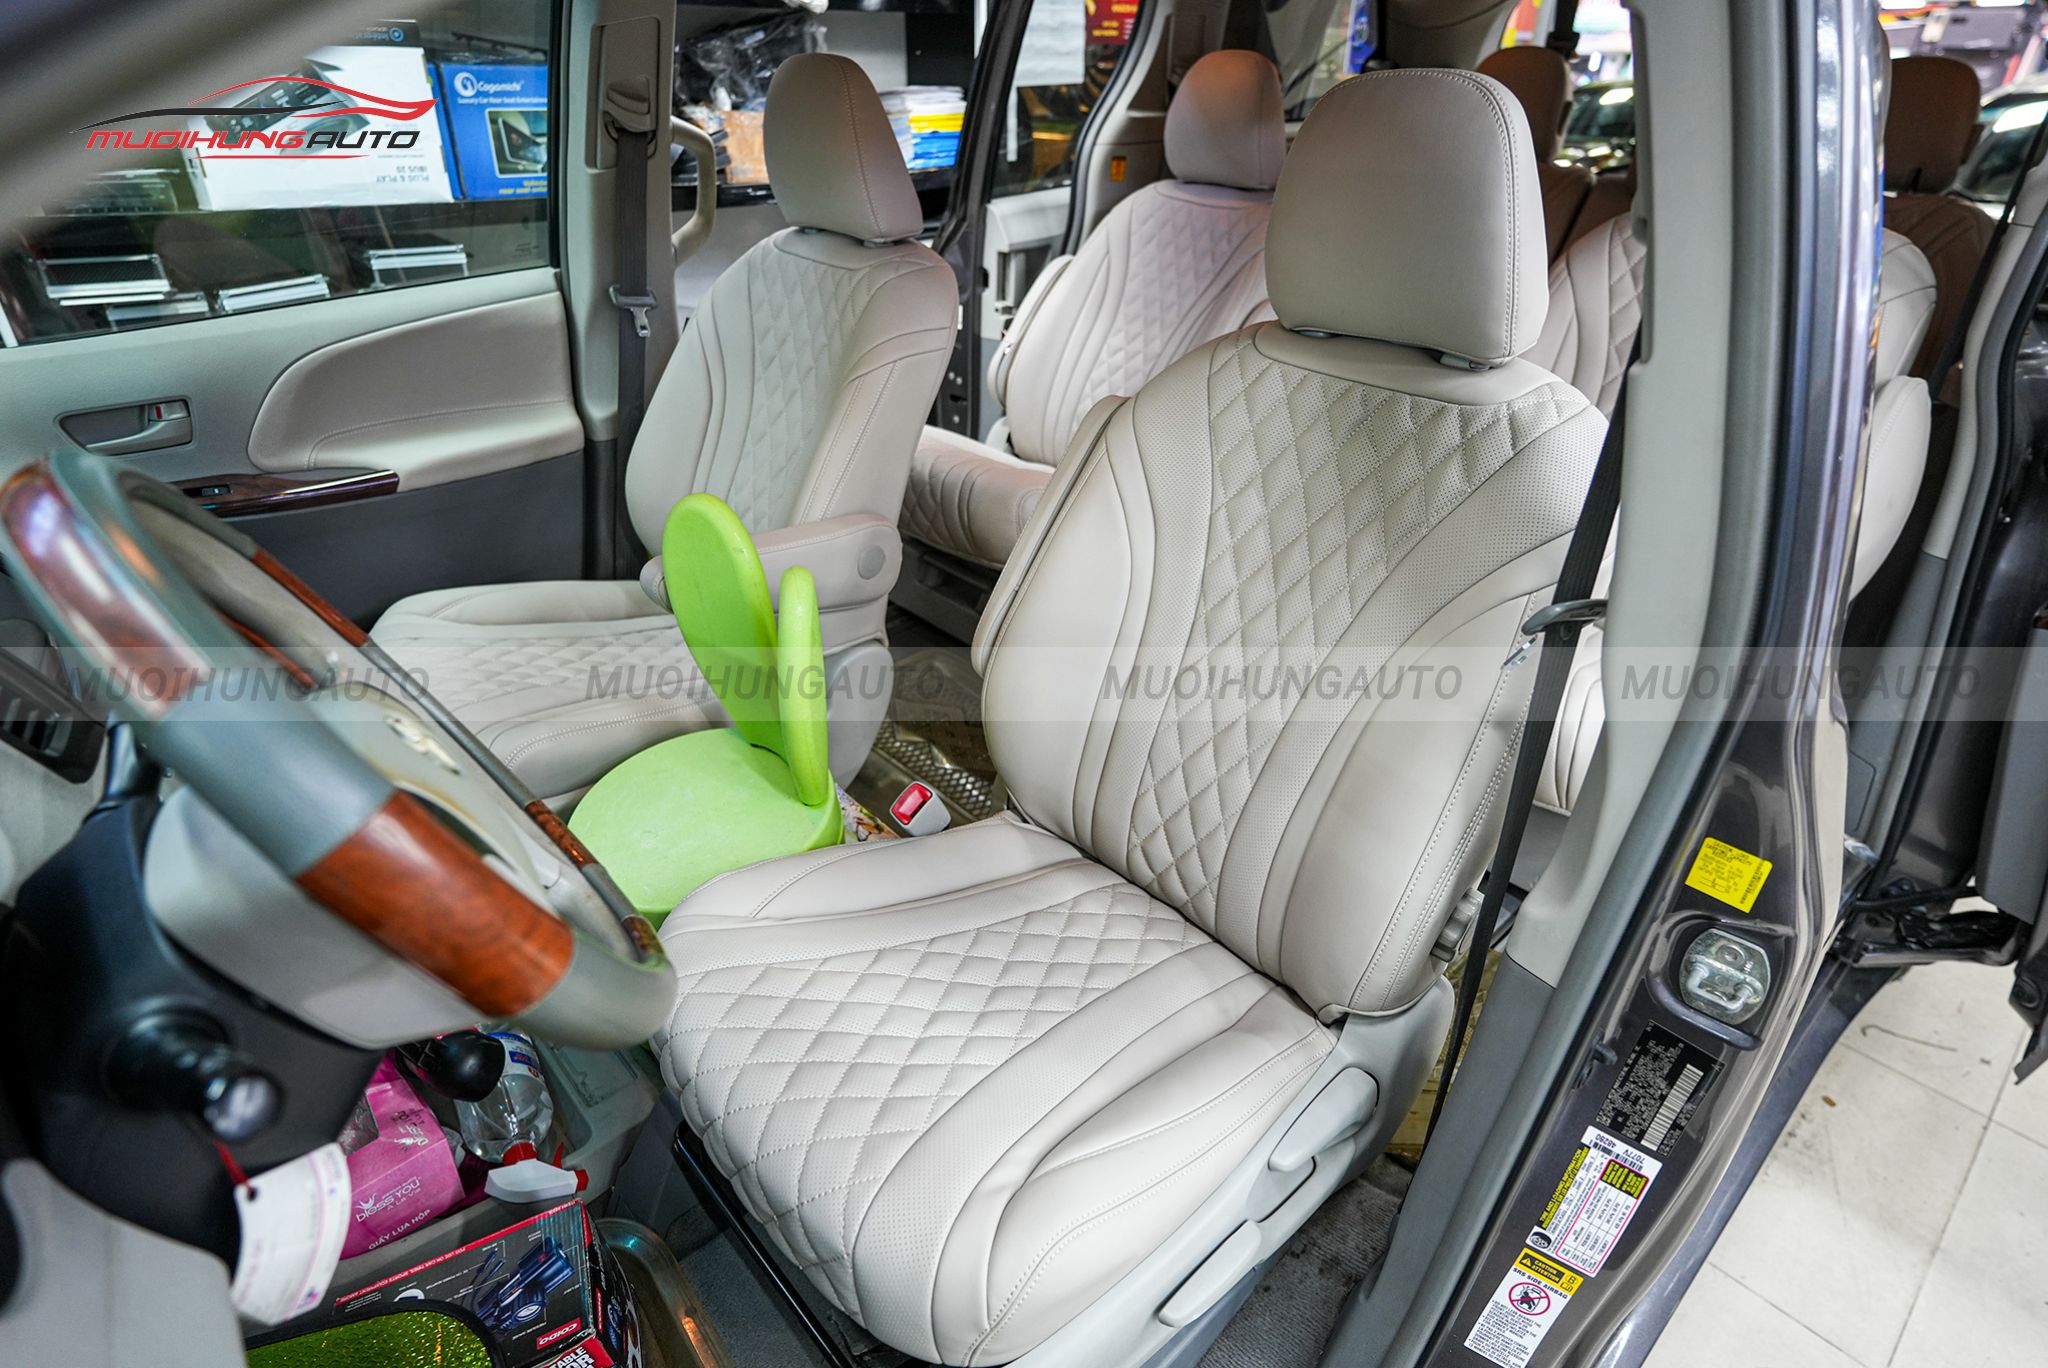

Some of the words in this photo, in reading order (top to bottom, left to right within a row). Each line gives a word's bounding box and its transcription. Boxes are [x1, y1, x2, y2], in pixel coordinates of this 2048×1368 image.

[1622, 1148, 1645, 1164] 7077V
[1545, 1200, 1554, 1211] AND
[1550, 1180, 1565, 1201] LOADING
[1561, 1148, 1582, 1181] INFORMATION
[1530, 1264, 1559, 1282] ATTENTION
[1533, 1259, 1557, 1274] CAUTION
[1512, 1267, 1526, 1276] SRS
[1526, 1274, 1542, 1285] SIDE
[1542, 1283, 1568, 1299] AIRBAG
[540, 1323, 577, 1345] COIDO
